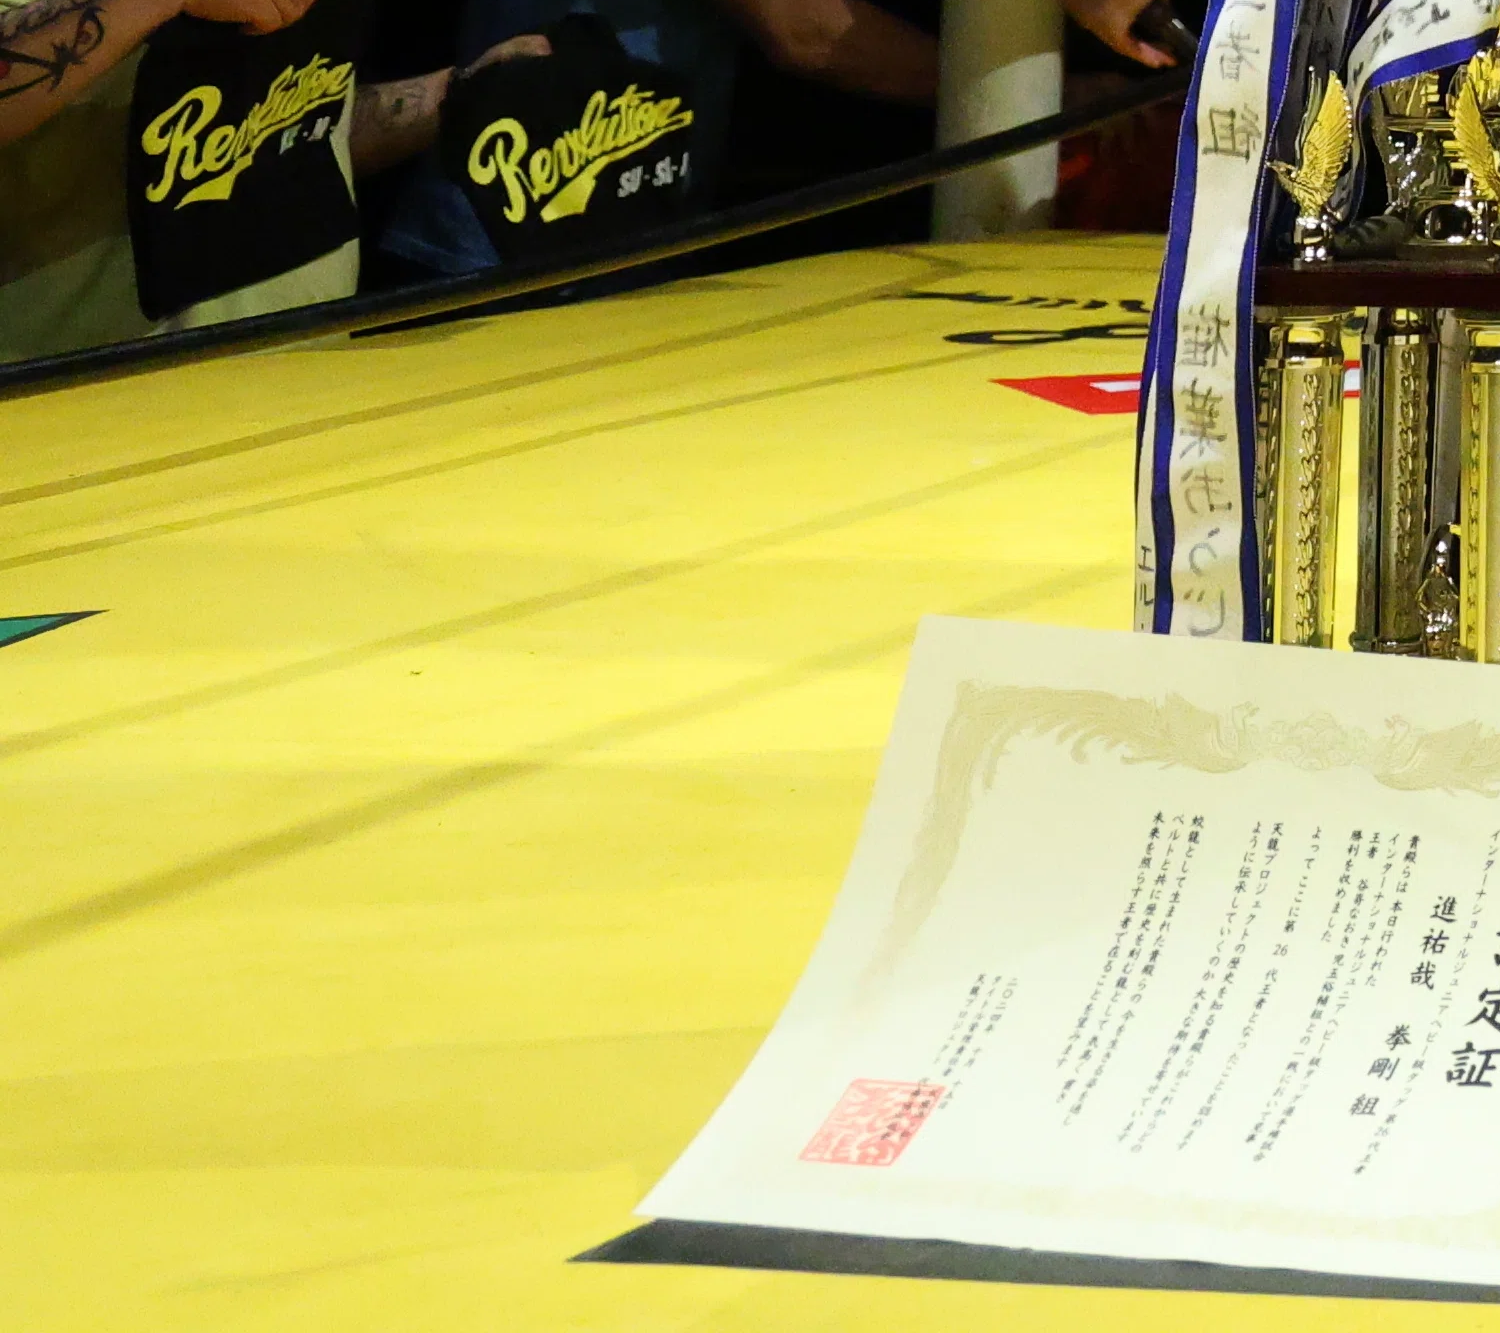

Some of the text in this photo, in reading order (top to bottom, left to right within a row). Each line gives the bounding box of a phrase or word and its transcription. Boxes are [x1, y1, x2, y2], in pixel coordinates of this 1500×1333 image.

[468, 83, 694, 223] Revolution
[1407, 894, 1460, 992] 進祐哉
